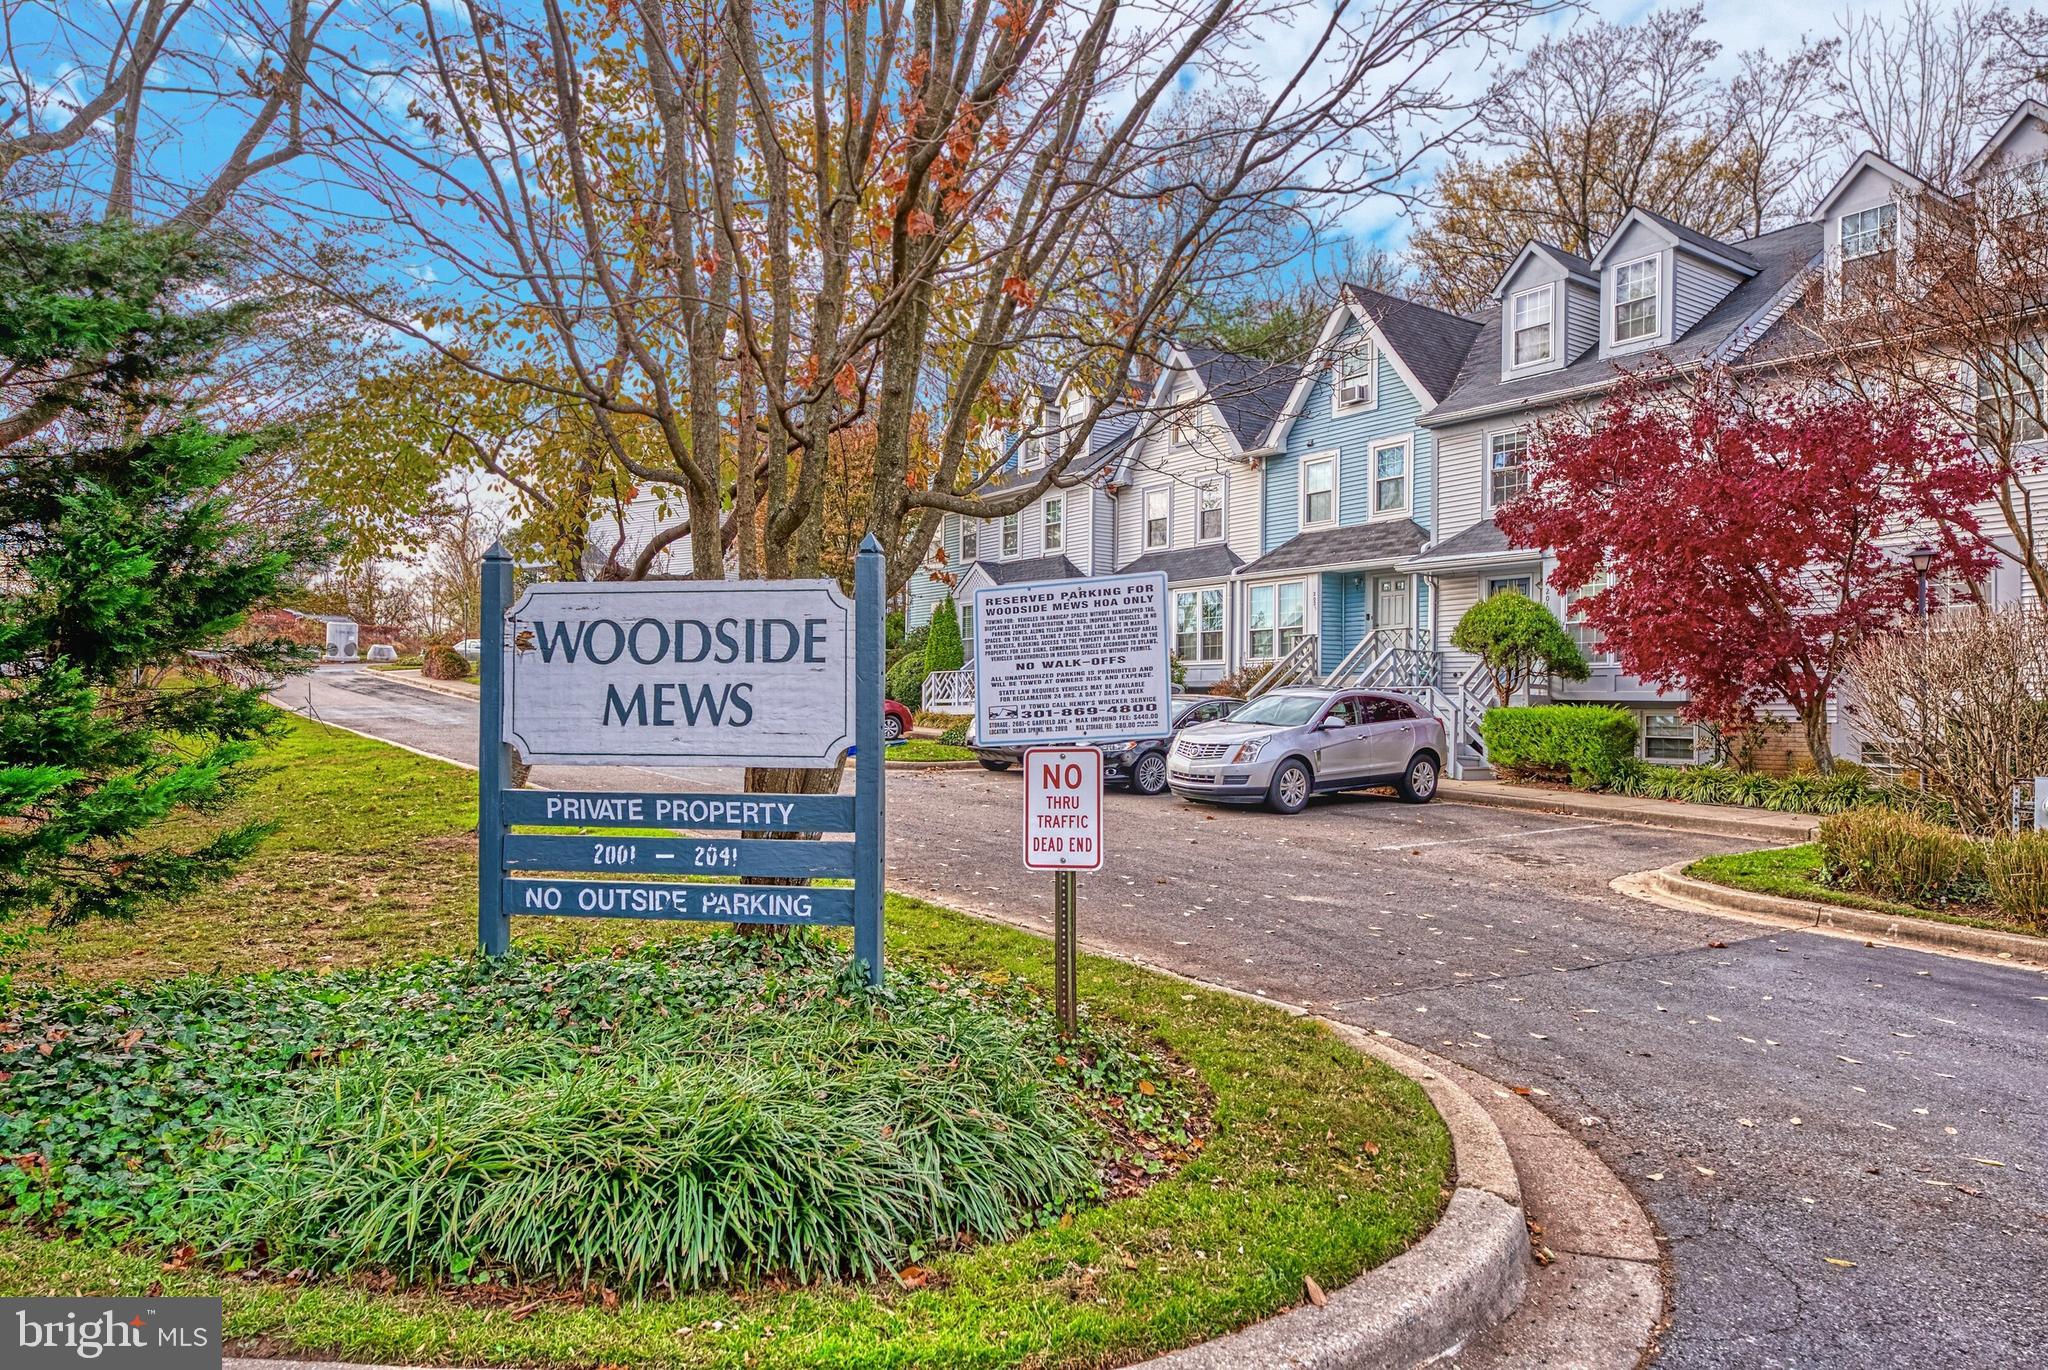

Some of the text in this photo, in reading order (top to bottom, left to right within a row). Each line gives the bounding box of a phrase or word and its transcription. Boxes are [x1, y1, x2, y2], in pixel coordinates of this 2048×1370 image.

[985, 584, 1153, 606] RESERVED PARKING FOR
[985, 595, 1153, 616] WOODSIDE MEWS HOA ONLY
[532, 617, 828, 666] WOODSIDE
[1015, 655, 1126, 670] NO WALK-OFFS
[1004, 672, 1053, 680] UNAUTHORIZED
[602, 682, 754, 729] MEWS
[1021, 702, 1157, 718] 301-869-4800
[1043, 764, 1082, 789] NO
[547, 798, 796, 825] PRIVATE PROPERTY
[1046, 796, 1080, 809] THRU
[1037, 815, 1088, 828] TRAFFIC
[1034, 837, 1092, 852] DEAD END
[525, 888, 813, 918] NO OUTSIDE PARKING
